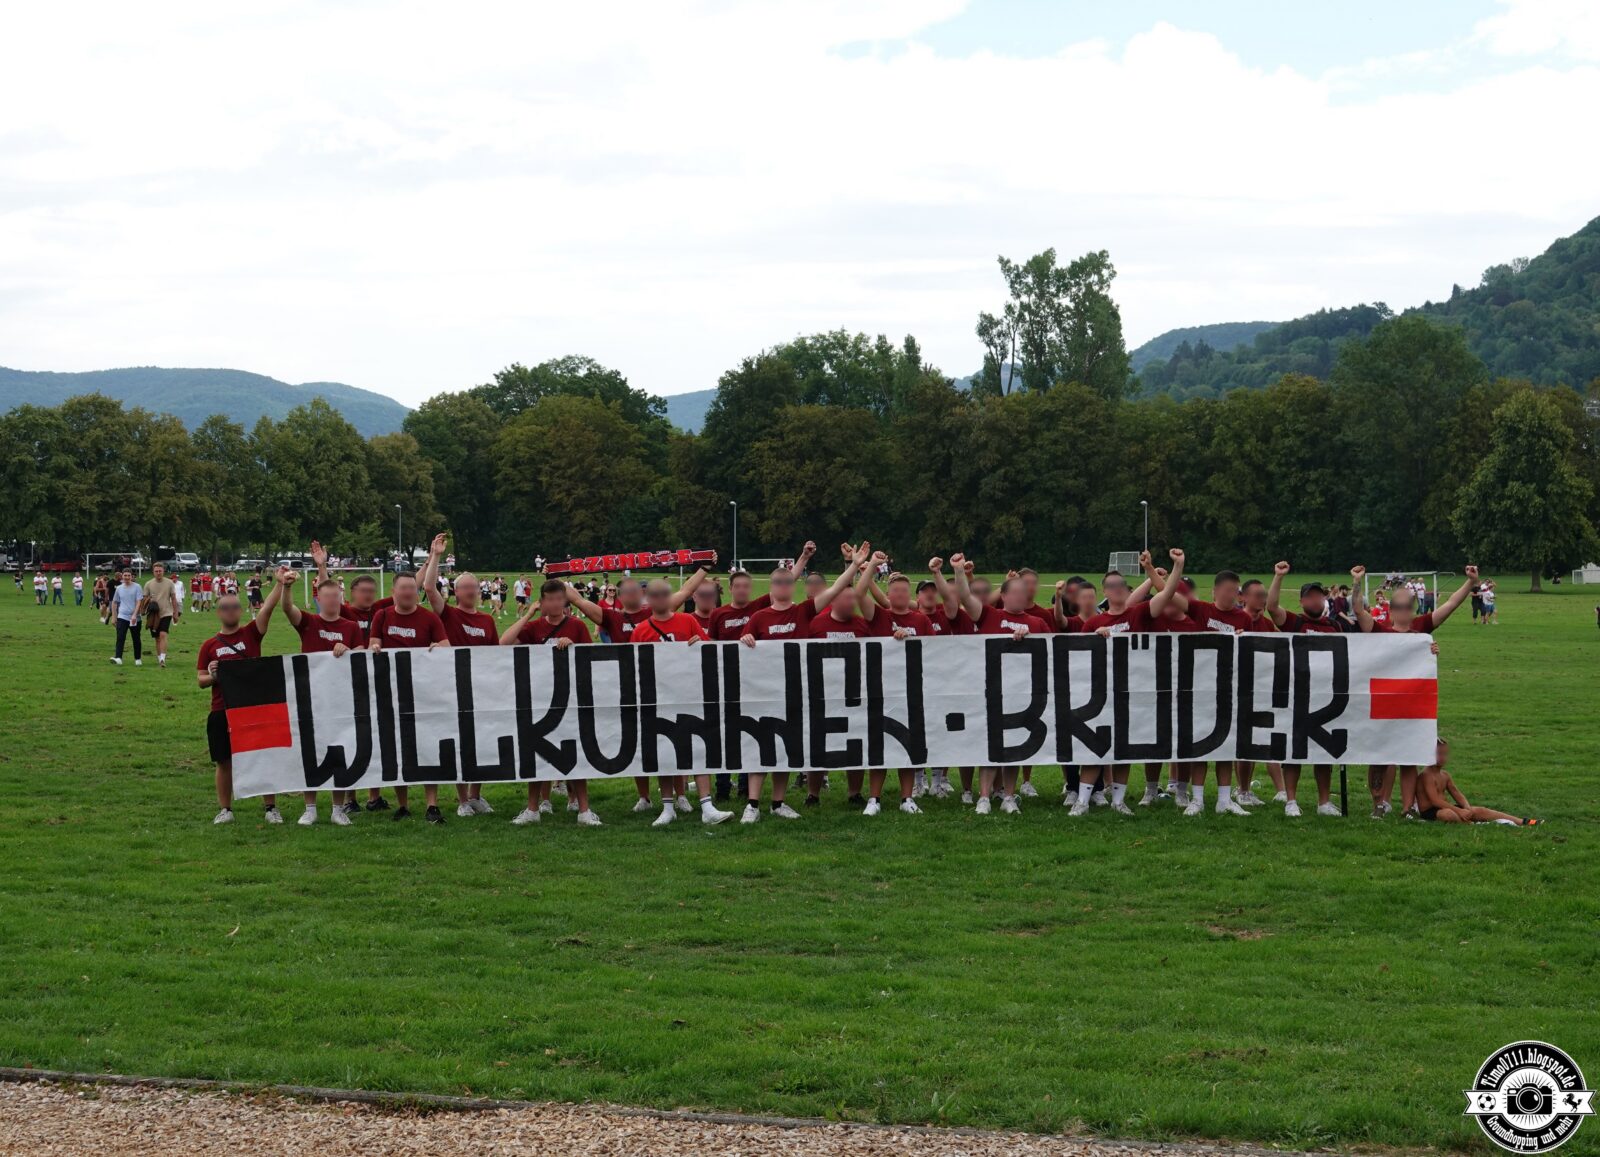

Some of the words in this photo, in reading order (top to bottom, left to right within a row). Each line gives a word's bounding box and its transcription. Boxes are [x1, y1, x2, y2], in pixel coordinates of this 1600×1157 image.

[569, 551, 653, 573] SZENE
[294, 640, 927, 785] WILLKOMMEN
[985, 634, 1348, 761] BRÜDER
